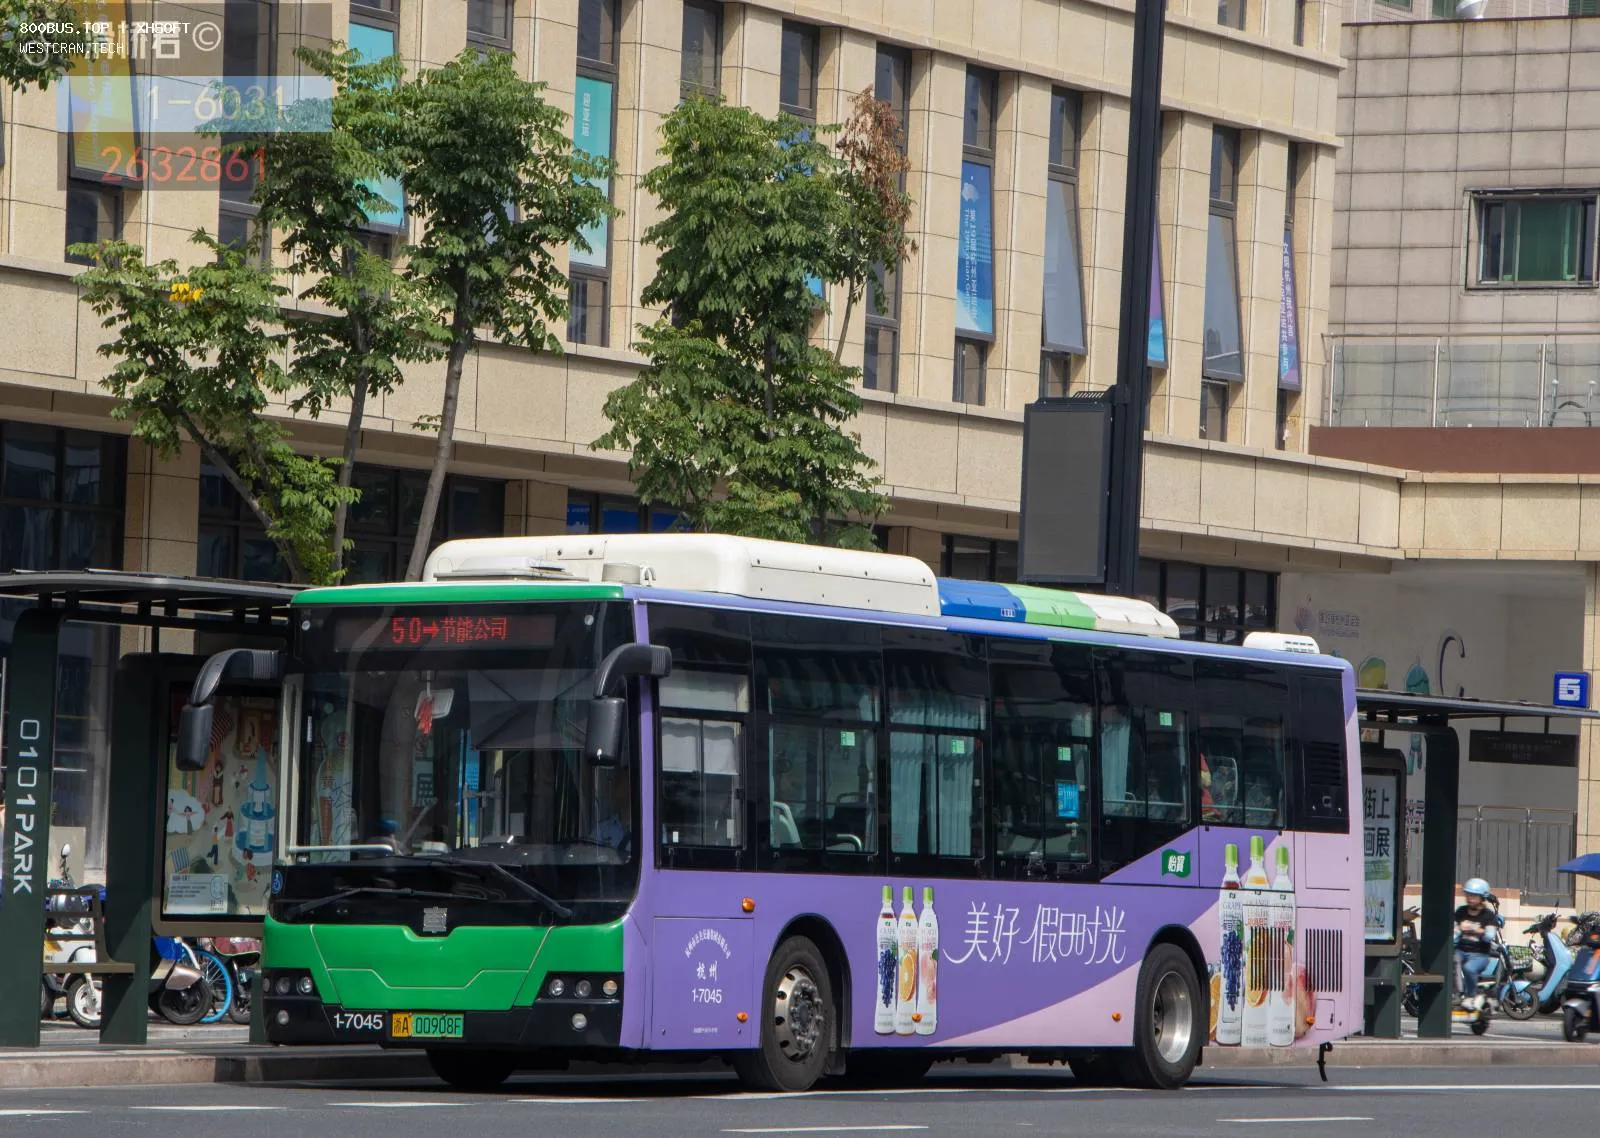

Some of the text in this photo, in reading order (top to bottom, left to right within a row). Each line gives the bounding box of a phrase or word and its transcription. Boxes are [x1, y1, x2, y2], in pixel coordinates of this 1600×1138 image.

[391, 615, 508, 645] 50 节能公司
[1558, 677, 1581, 702] 6
[691, 987, 723, 1004] 1-7045
[333, 1012, 384, 1030] 1-7045
[414, 1016, 462, 1034] 00908F
